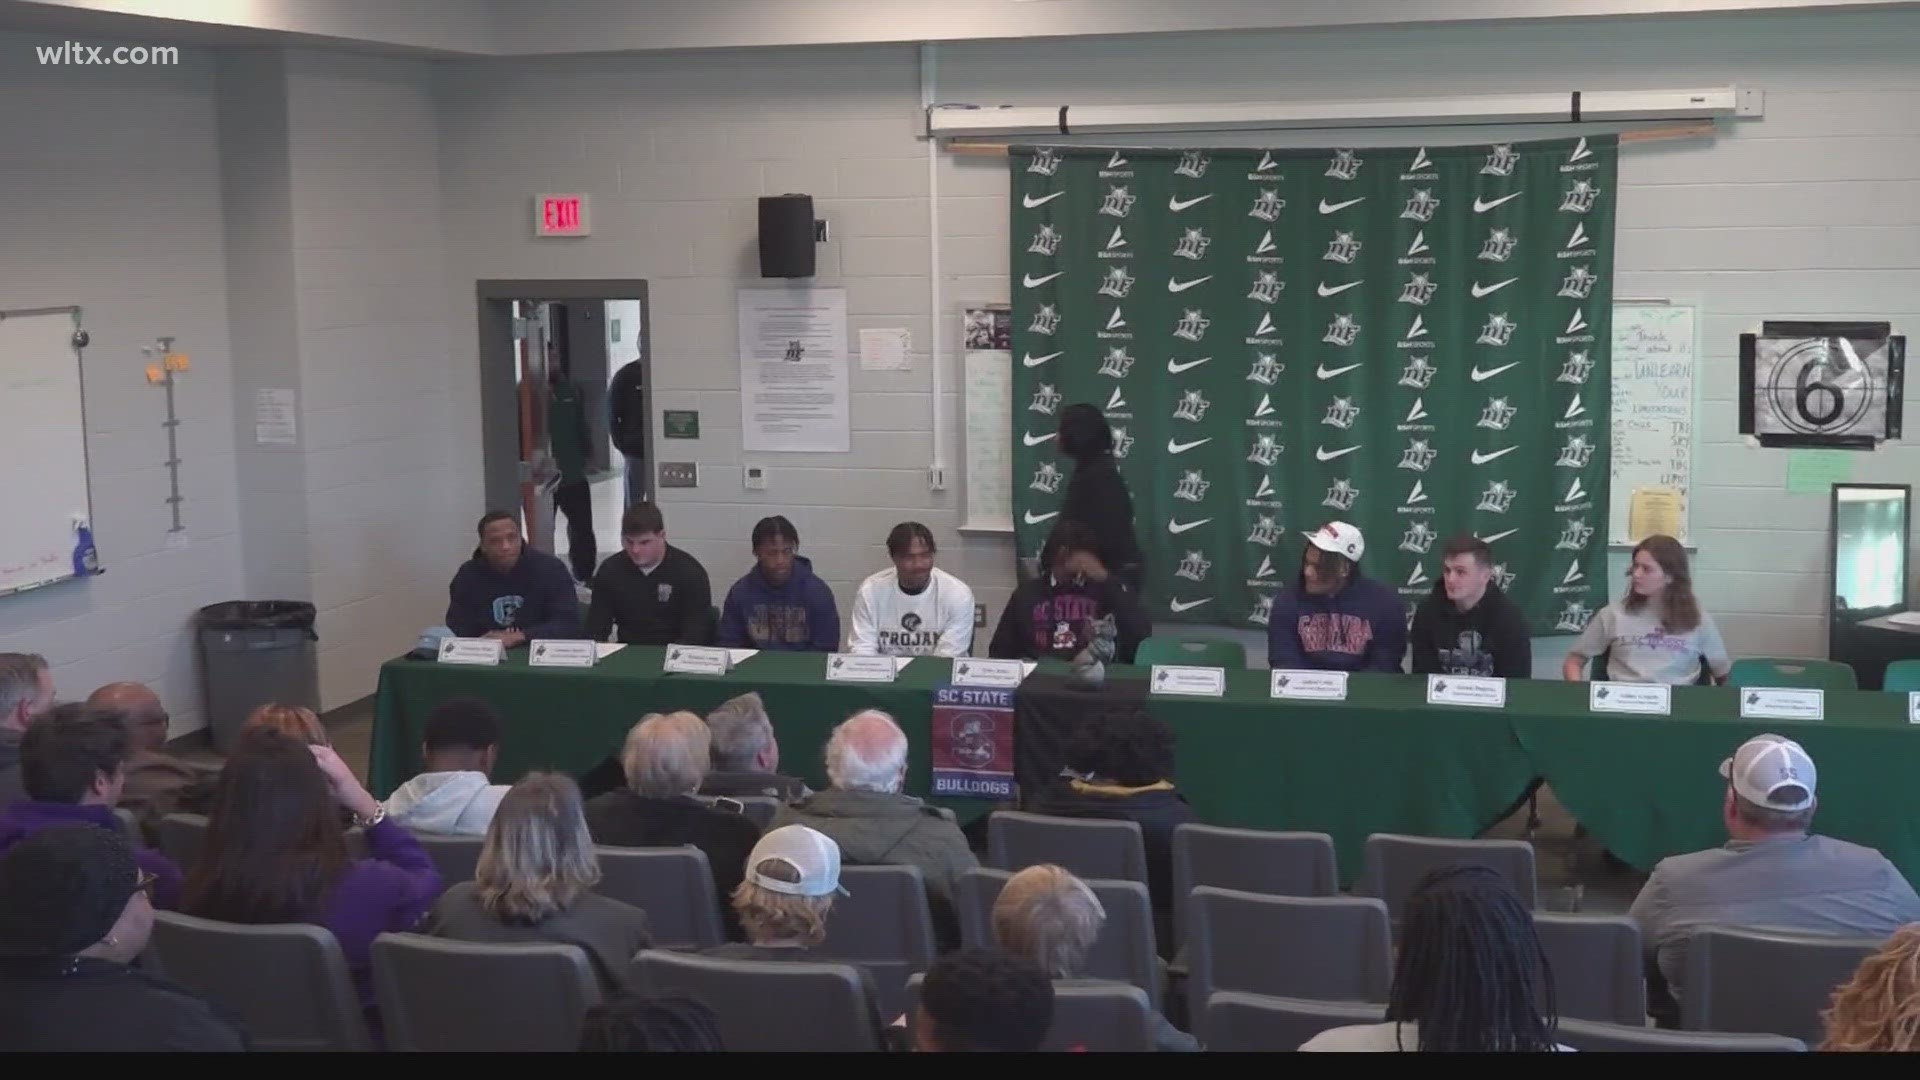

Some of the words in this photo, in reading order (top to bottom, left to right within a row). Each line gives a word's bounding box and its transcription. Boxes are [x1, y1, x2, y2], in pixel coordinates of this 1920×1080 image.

[544, 199, 580, 227] EXIT
[1797, 358, 1845, 426] 6
[937, 689, 959, 703] SC
[962, 690, 1008, 705] STATE
[936, 778, 1010, 795] BULLDOGS
